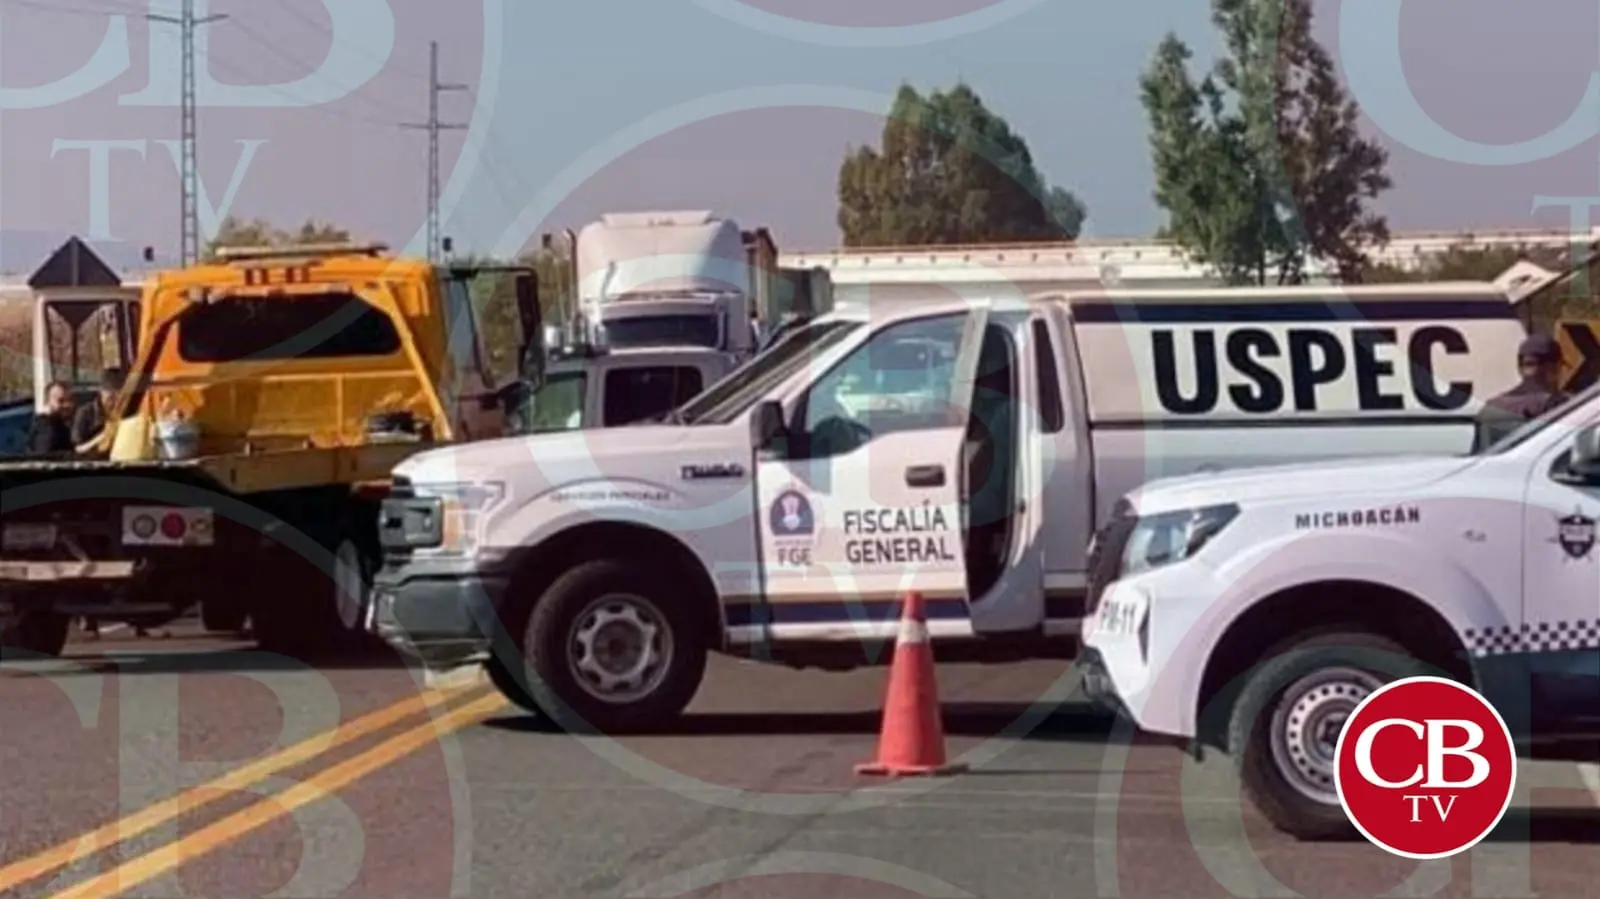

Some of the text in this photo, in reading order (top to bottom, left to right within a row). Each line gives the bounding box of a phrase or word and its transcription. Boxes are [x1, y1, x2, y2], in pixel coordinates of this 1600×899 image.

[1151, 325, 1474, 415] USPEC
[843, 499, 948, 535] FISCALÍA
[845, 536, 955, 564] GENERAL
